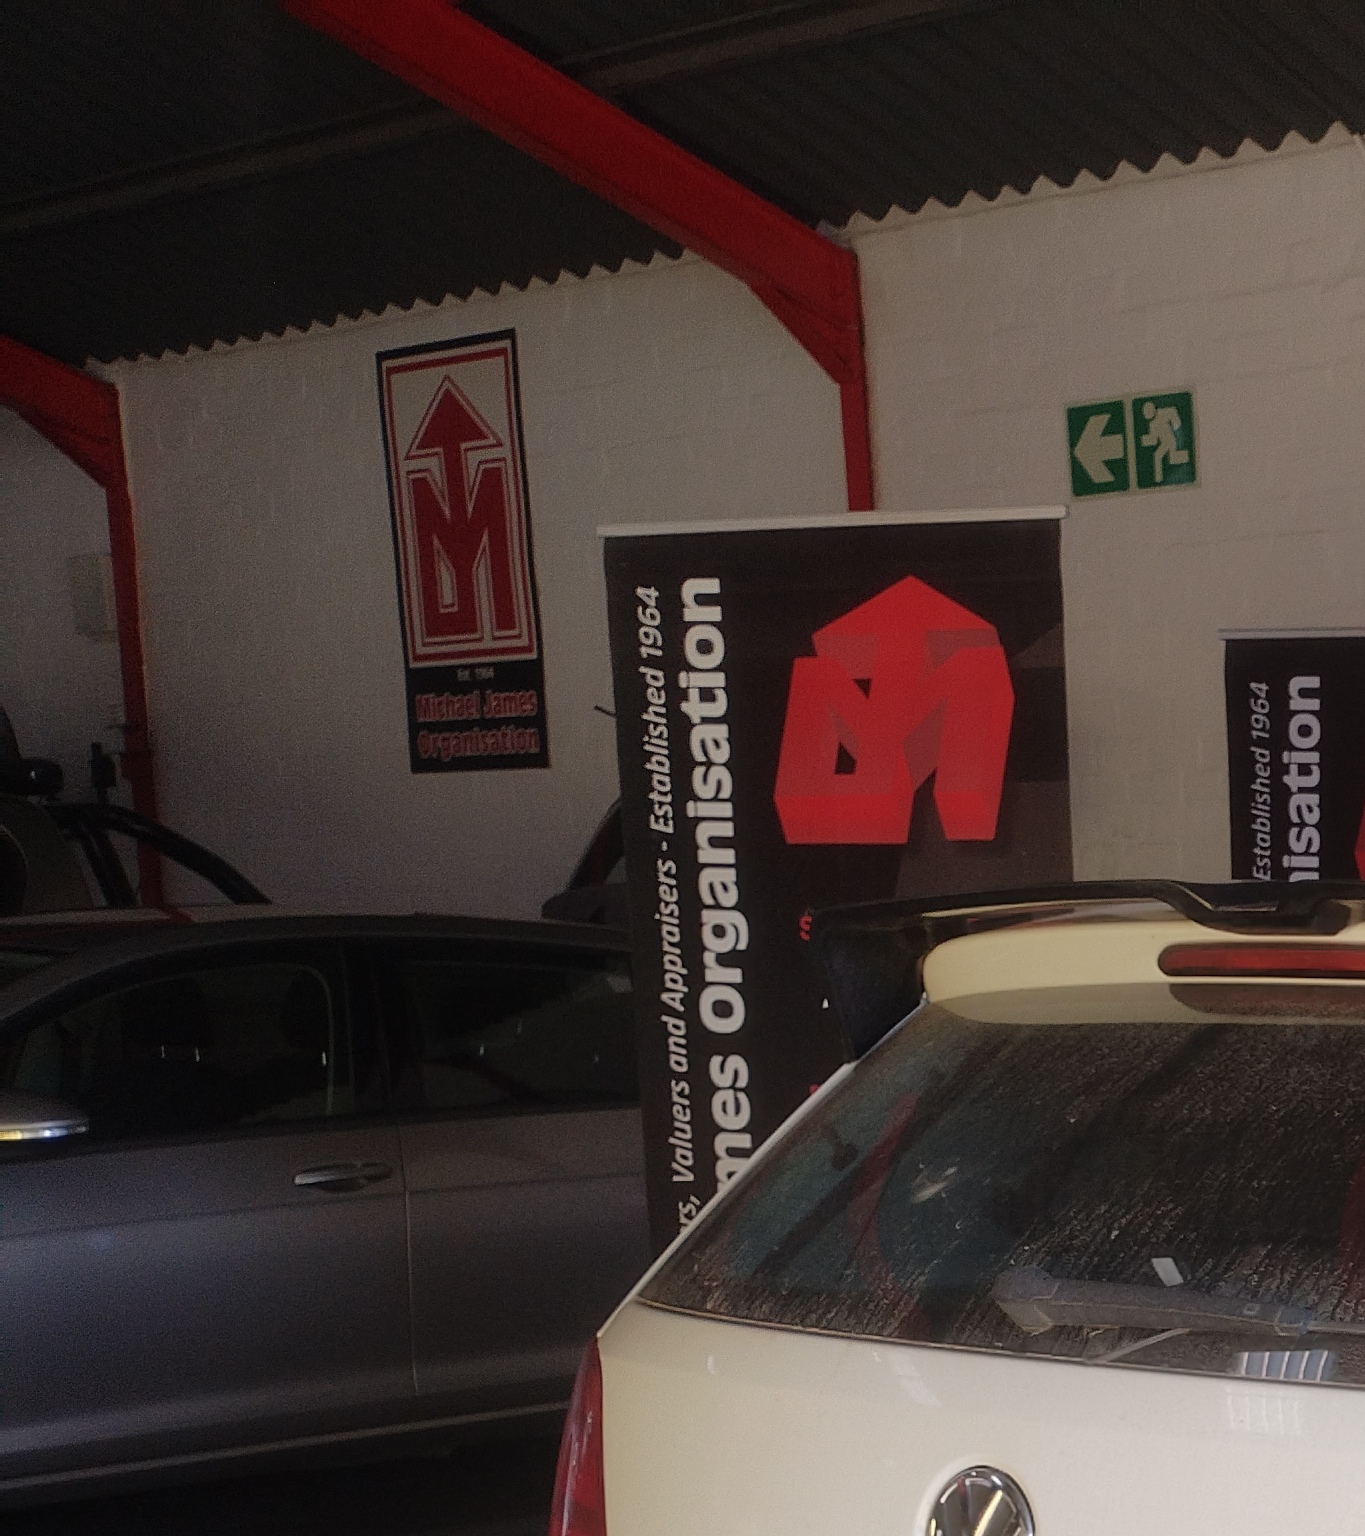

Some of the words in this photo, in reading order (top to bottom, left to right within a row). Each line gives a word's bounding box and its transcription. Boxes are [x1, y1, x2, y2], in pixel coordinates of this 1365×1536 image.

[635, 586, 663, 659] 1964
[415, 690, 481, 722] Michael
[483, 689, 538, 718] James
[416, 725, 541, 762] Organisation
[638, 665, 674, 834] Established
[1249, 681, 1271, 740] 1964
[678, 577, 749, 1034] Organisation
[1249, 745, 1272, 881] Established
[654, 858, 689, 1012] Appraisers
[660, 1014, 689, 1073] and
[668, 1079, 695, 1182] Valuers
